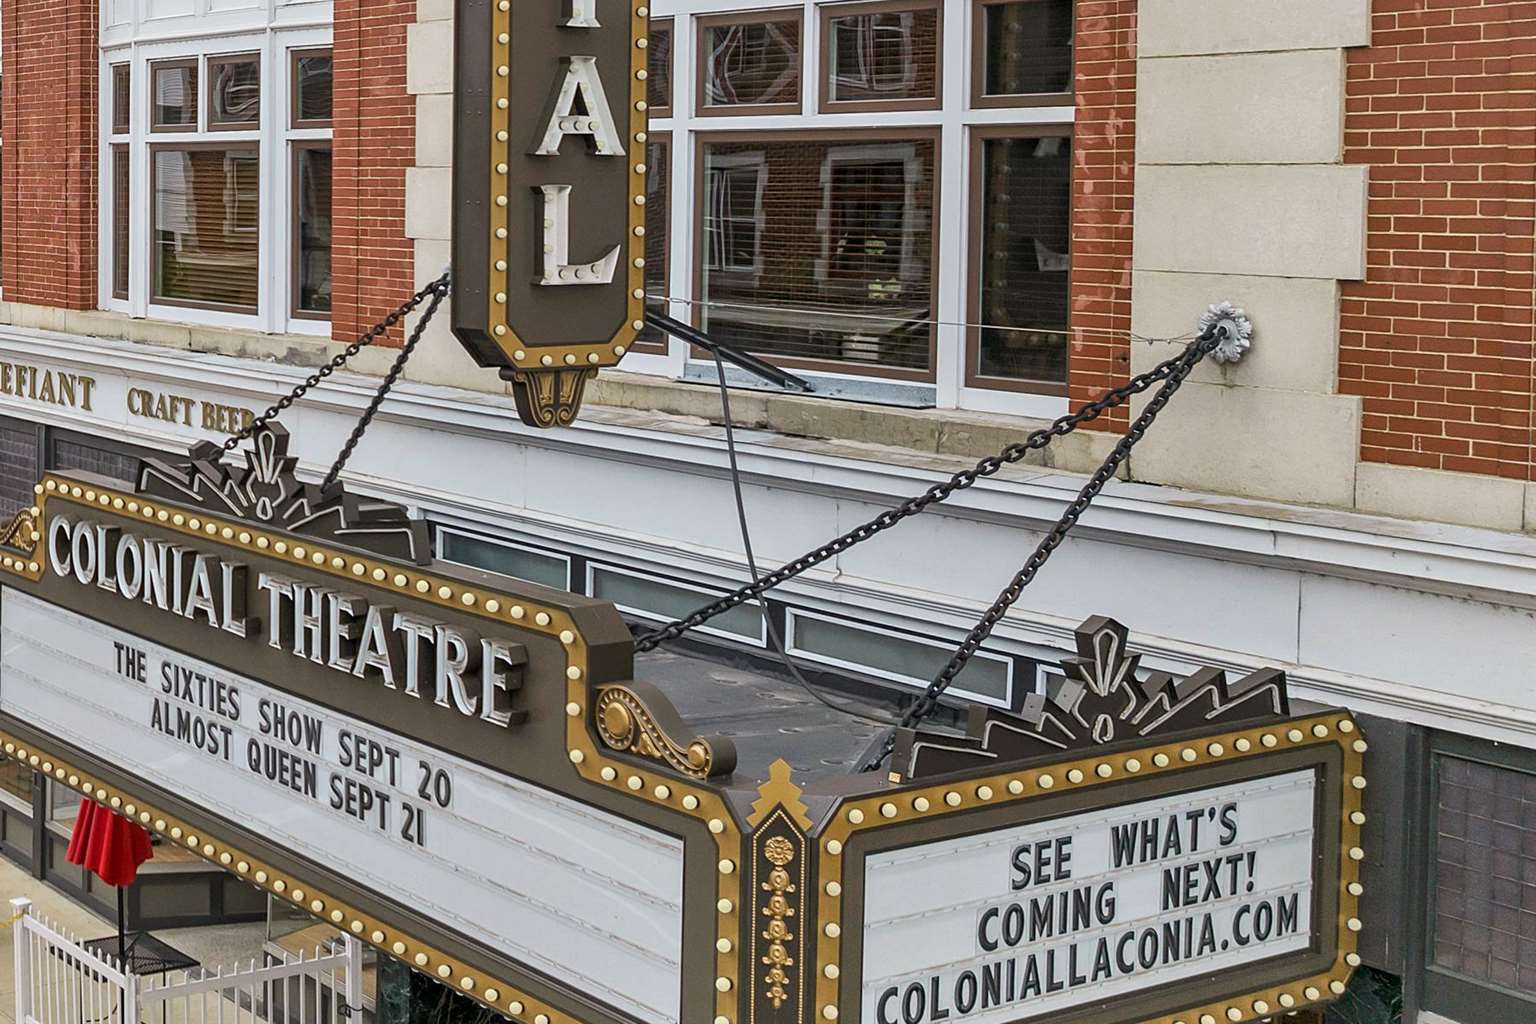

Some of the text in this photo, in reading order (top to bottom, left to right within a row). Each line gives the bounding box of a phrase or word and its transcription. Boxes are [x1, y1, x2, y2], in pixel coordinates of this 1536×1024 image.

[127, 387, 195, 427] CRAFT
[48, 513, 527, 729] COLONIAL THEATRE
[113, 641, 452, 808] THE SIXTIES SHOW SEPT 20
[151, 697, 425, 847] ALMOST QUEEN SEPT 21
[978, 850, 1257, 952] COMING NEXT!
[1010, 801, 1238, 891] SEE WHAT'S
[876, 892, 1298, 1024] COLONIALLACONIA.COM
